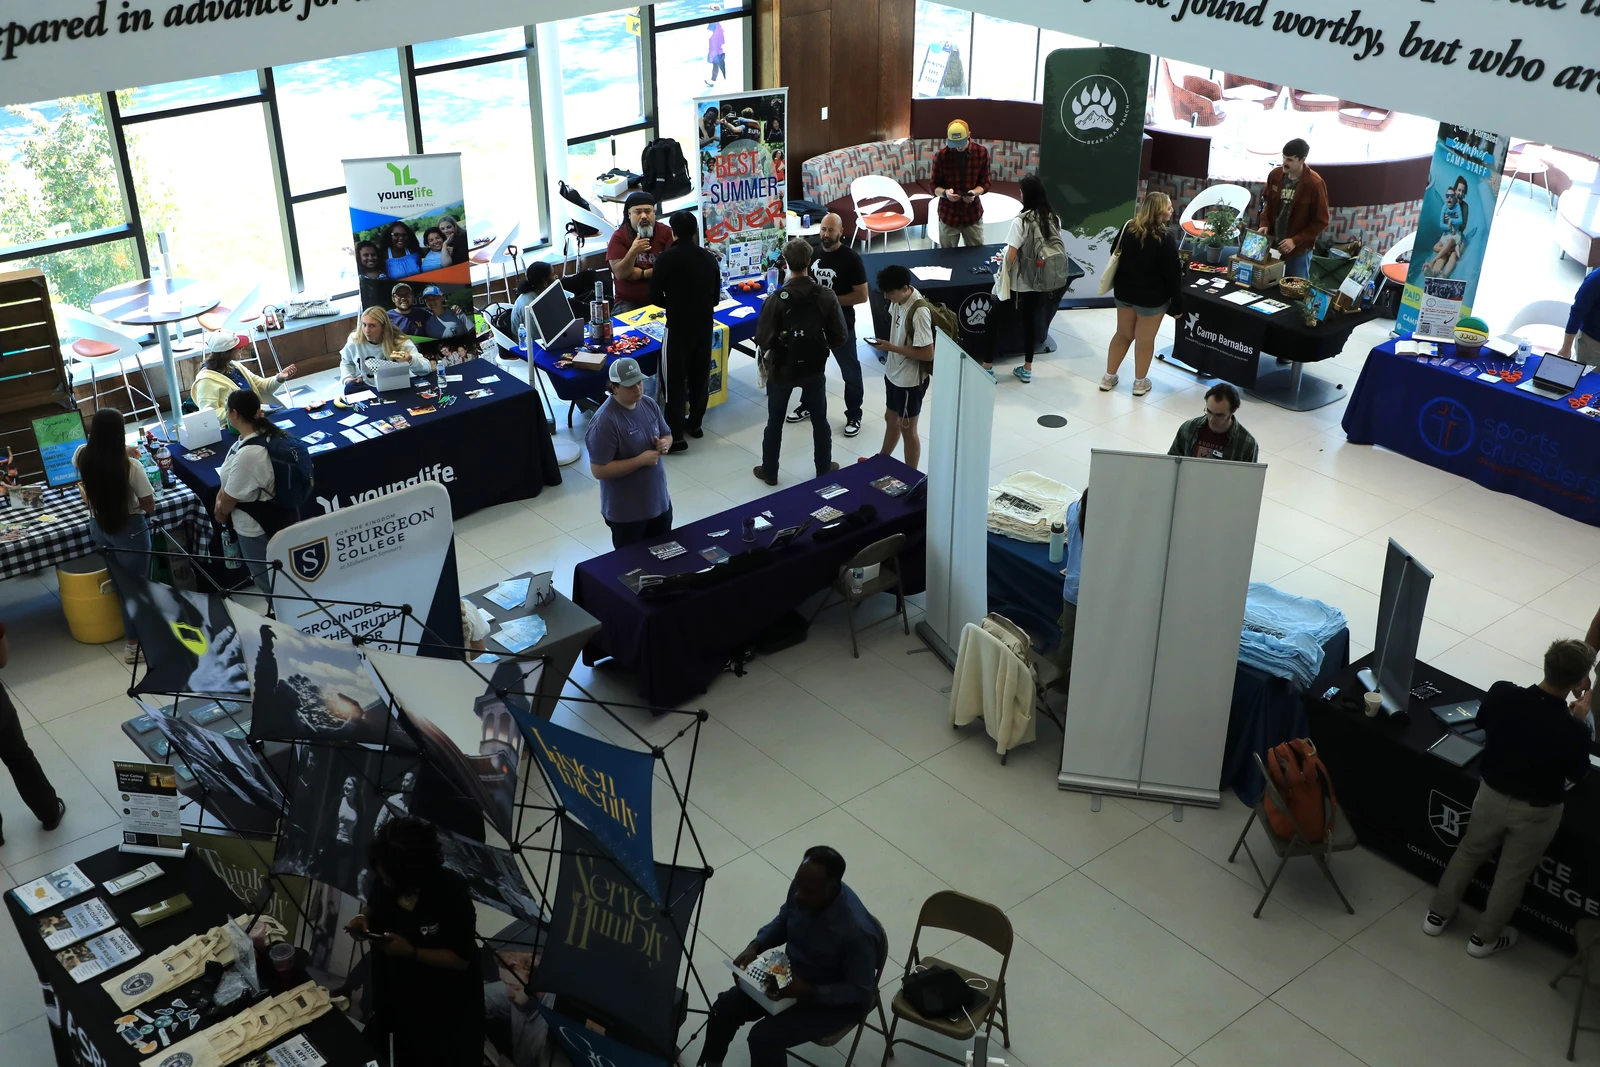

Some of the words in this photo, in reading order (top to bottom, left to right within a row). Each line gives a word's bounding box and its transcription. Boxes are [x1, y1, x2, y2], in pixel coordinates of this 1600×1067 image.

[0, 2, 108, 60] pared
[118, 2, 154, 33] in
[164, 0, 293, 27] advance
[1171, 0, 1264, 27] found
[1272, 10, 1385, 61] worthy,
[1399, 20, 1462, 65] but
[1467, 39, 1545, 82] who
[1552, 65, 1600, 95] ar
[1105, 127, 1120, 140] TRAP
[1119, 104, 1130, 126] RANCH
[1452, 136, 1489, 161] Summer
[715, 150, 760, 179] BEST
[1445, 152, 1465, 168] CAMP
[1466, 160, 1488, 177] STAFF
[377, 186, 434, 203] younglife
[710, 176, 778, 205] SUMMER
[705, 200, 786, 243] EVER
[816, 270, 831, 279] KAA
[1403, 288, 1421, 302] PAID
[1196, 325, 1218, 343] Camp
[1218, 333, 1254, 355] Barnabas
[1483, 418, 1561, 458] sports
[1479, 438, 1600, 494] crusaders
[335, 529, 348, 537] FOR
[350, 523, 363, 532] THE
[365, 513, 396, 528] KINGDOM
[336, 506, 435, 552] SPURGEON
[301, 546, 320, 574] S
[338, 532, 406, 562] COLLEGE
[346, 554, 378, 569] Midwestern
[377, 545, 403, 559] Seminary
[531, 726, 616, 798] Listen
[1406, 843, 1448, 869] LOUISVILL
[572, 847, 656, 921] Serve
[1533, 871, 1600, 917] LEGE
[83, 903, 104, 928] PHILOSOPHY
[94, 903, 110, 921] DOCTOR
[109, 937, 127, 956] MINISTRY
[118, 933, 135, 951] DOCTOR
[563, 896, 669, 970] Humbly
[294, 1049, 307, 1062] ARTS
[301, 1041, 319, 1061] MASTER
